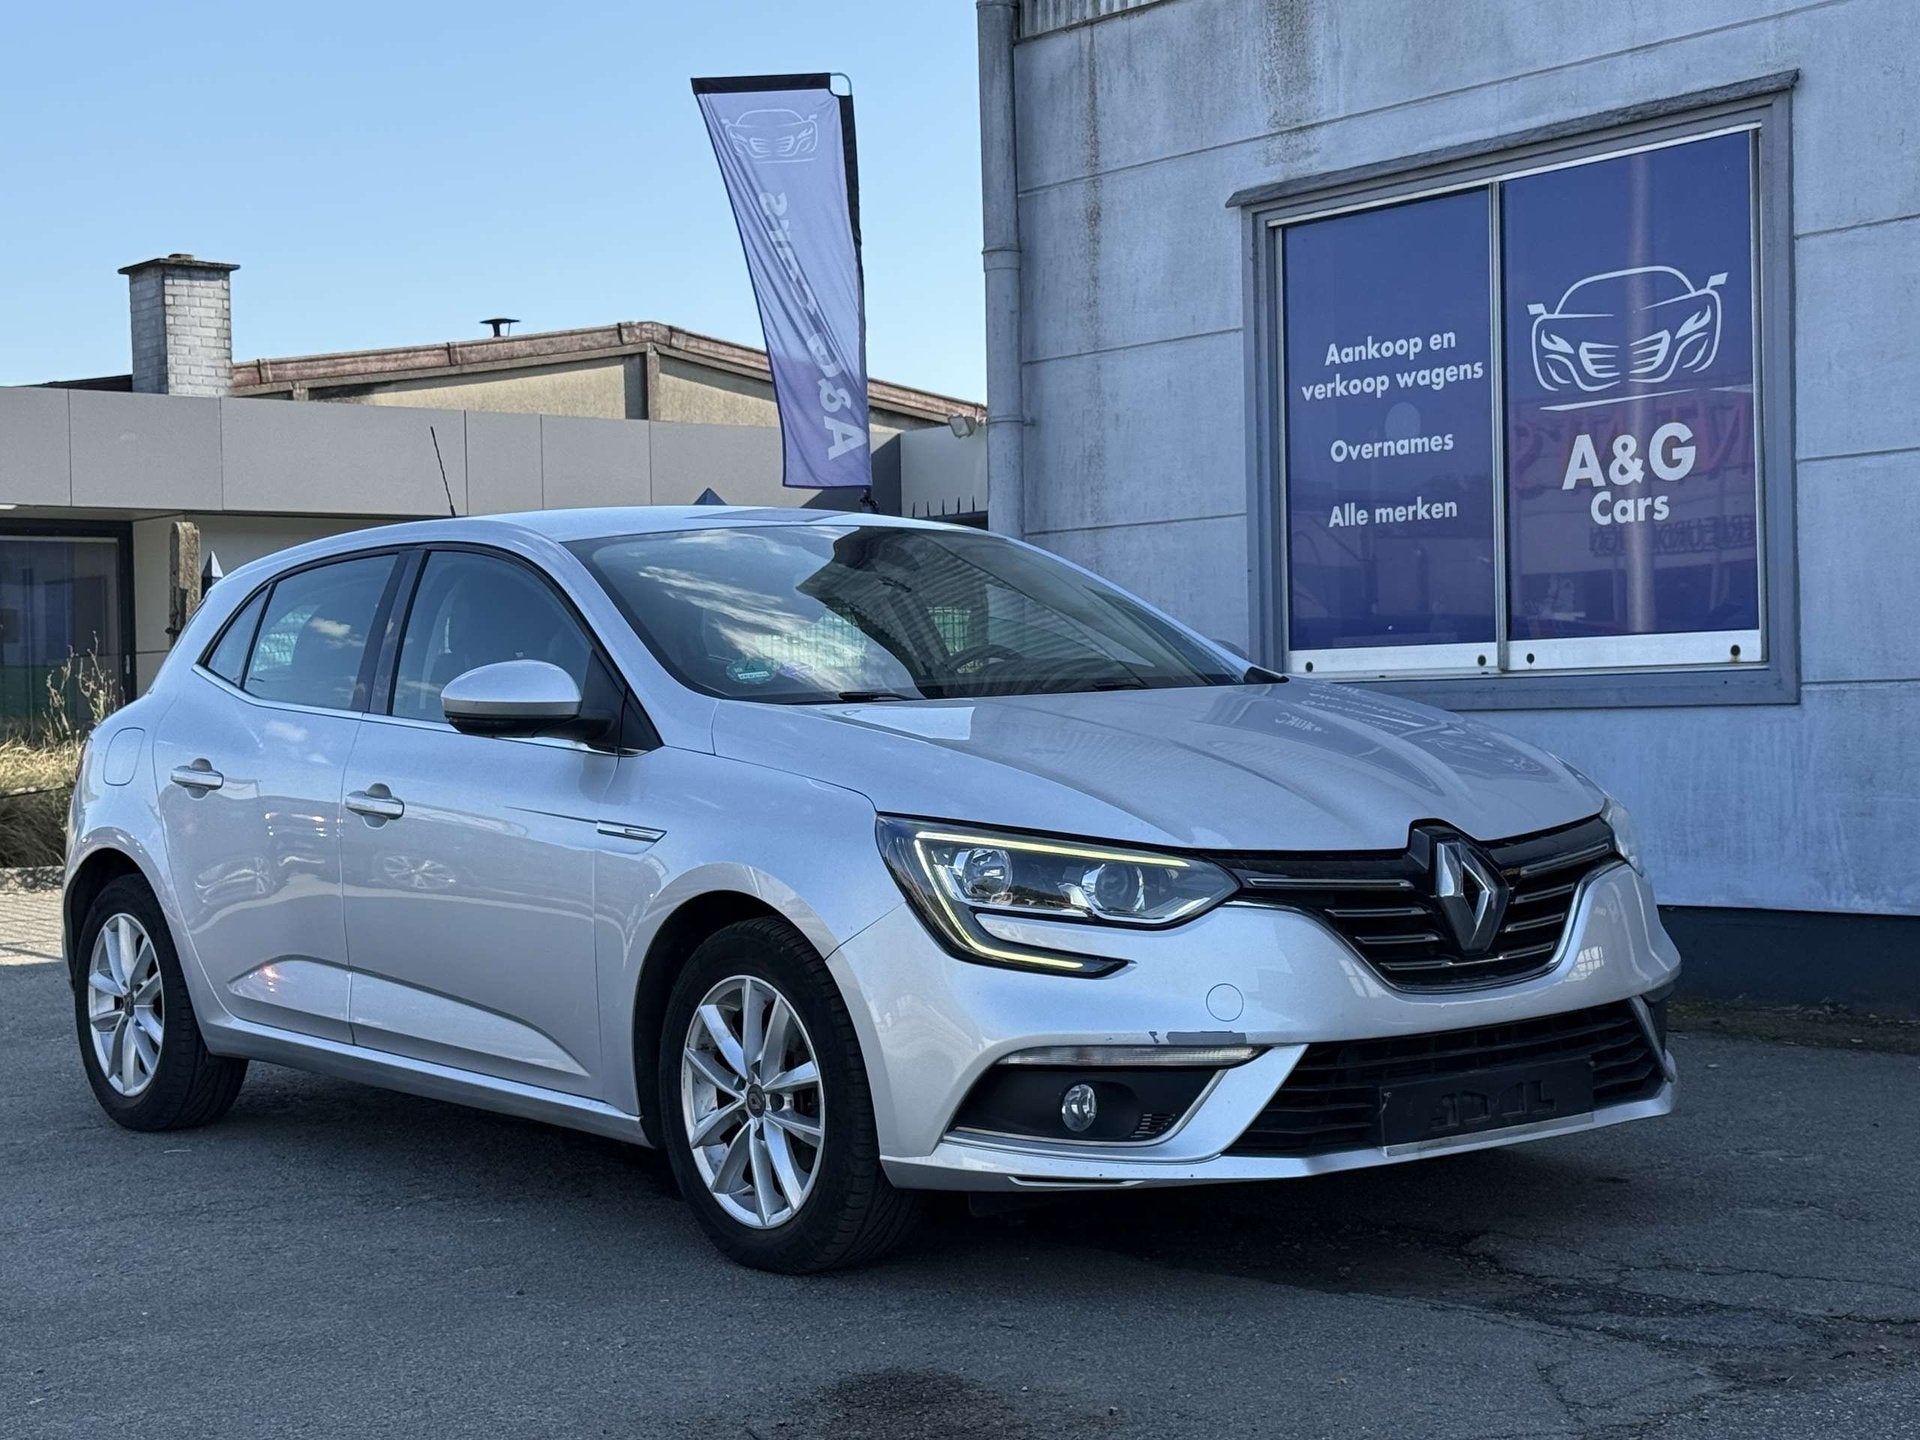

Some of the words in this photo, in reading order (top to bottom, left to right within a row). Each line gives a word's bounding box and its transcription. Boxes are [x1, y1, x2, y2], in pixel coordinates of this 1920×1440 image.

[1325, 335, 1423, 366] Aankoop
[1429, 331, 1456, 351] en
[1301, 373, 1390, 401] verkoop
[1395, 361, 1484, 391] wagens
[1330, 433, 1454, 463] Overnames
[1562, 421, 1697, 490] A&G
[1327, 502, 1369, 528] Alle
[1374, 496, 1458, 524] merken
[1589, 490, 1671, 526] Cars
